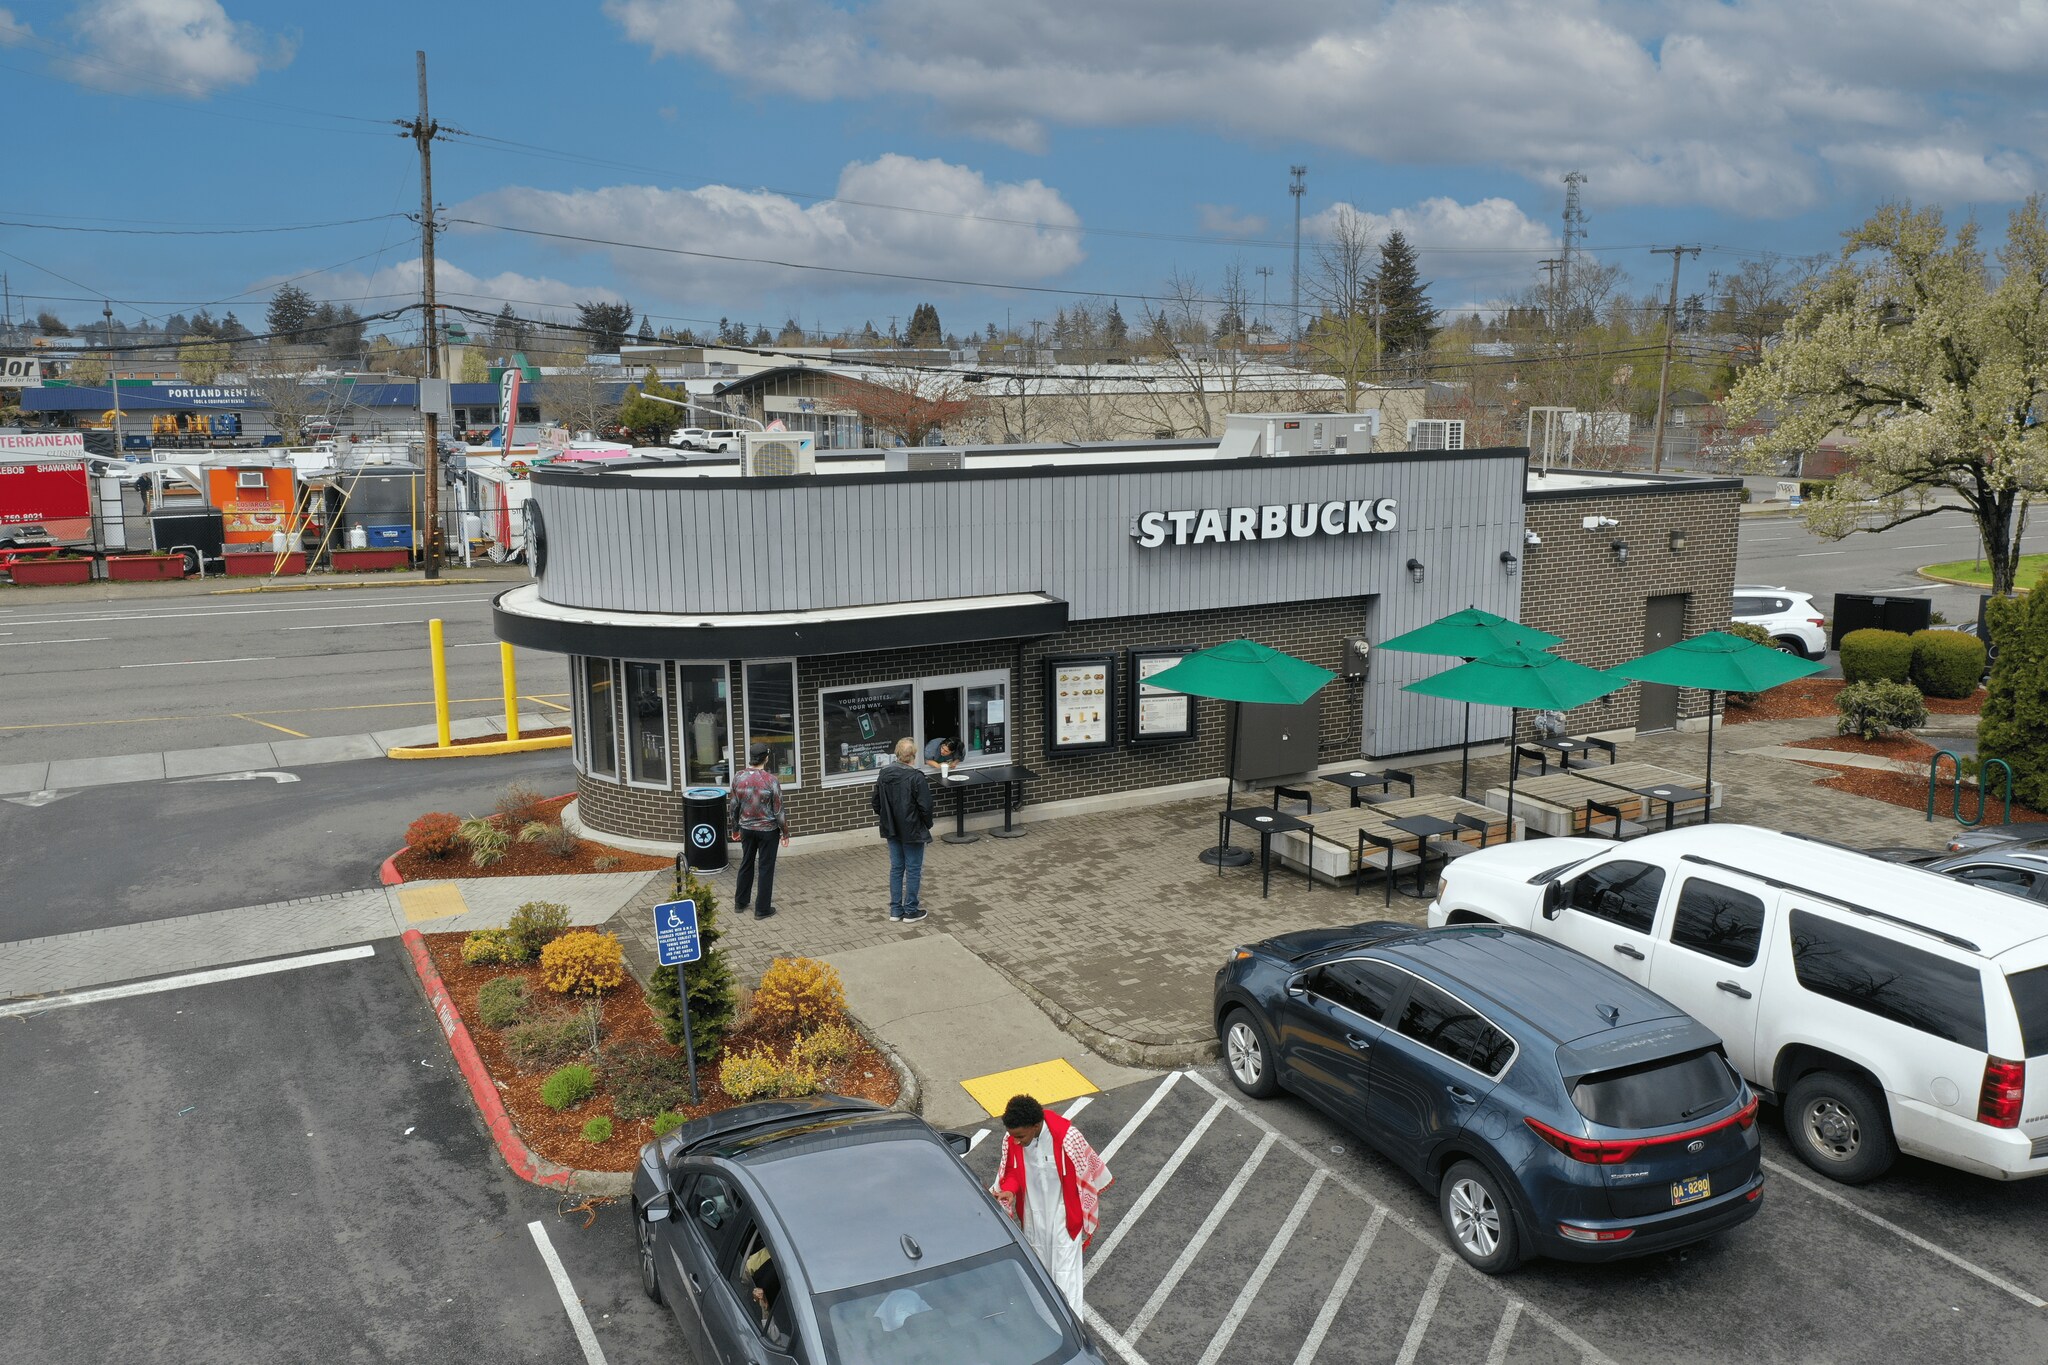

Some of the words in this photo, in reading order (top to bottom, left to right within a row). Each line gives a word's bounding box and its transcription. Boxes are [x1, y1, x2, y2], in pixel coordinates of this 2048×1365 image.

[168, 389, 221, 398] PORTLAND
[0, 435, 82, 448] TERRANEAN
[47, 449, 83, 457] CUISINE
[37, 463, 83, 473] SHAWARMA
[1137, 498, 1398, 548] STARBUCKS
